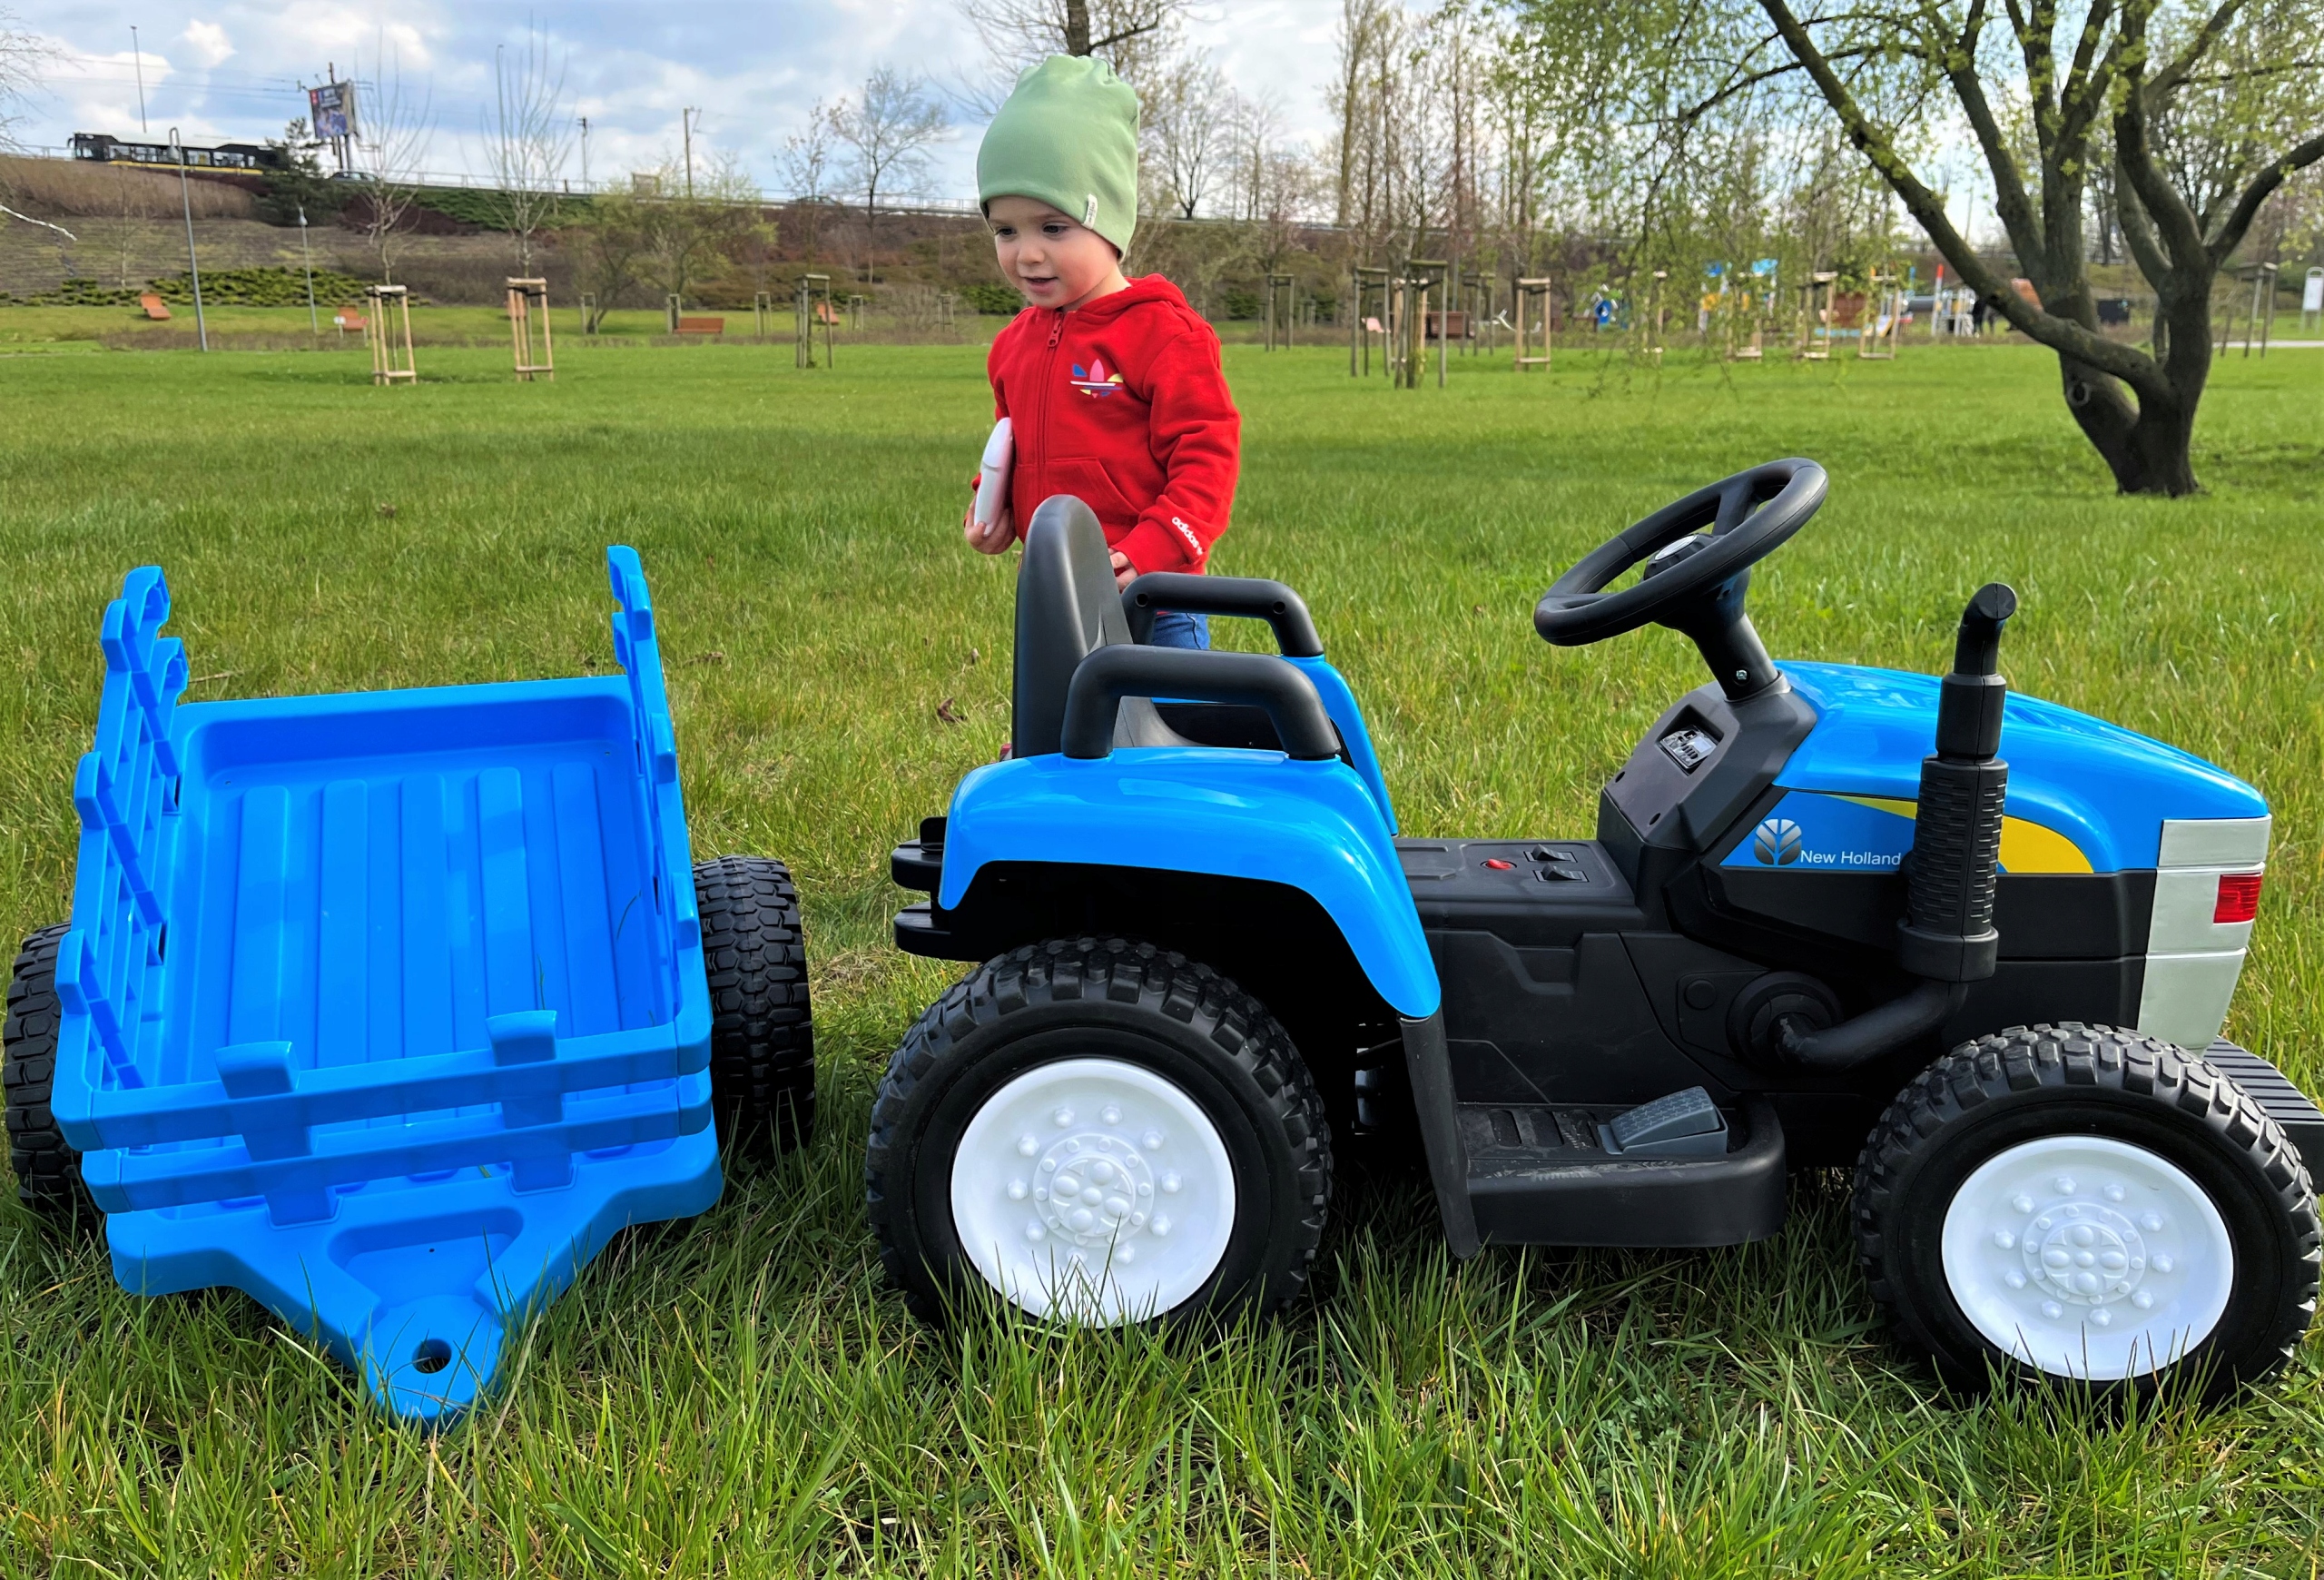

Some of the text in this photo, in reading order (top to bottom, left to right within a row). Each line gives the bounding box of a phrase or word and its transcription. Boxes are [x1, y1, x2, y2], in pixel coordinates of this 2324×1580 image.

[1171, 517, 1199, 548] adidas
[1800, 850, 1901, 864] New Holland
